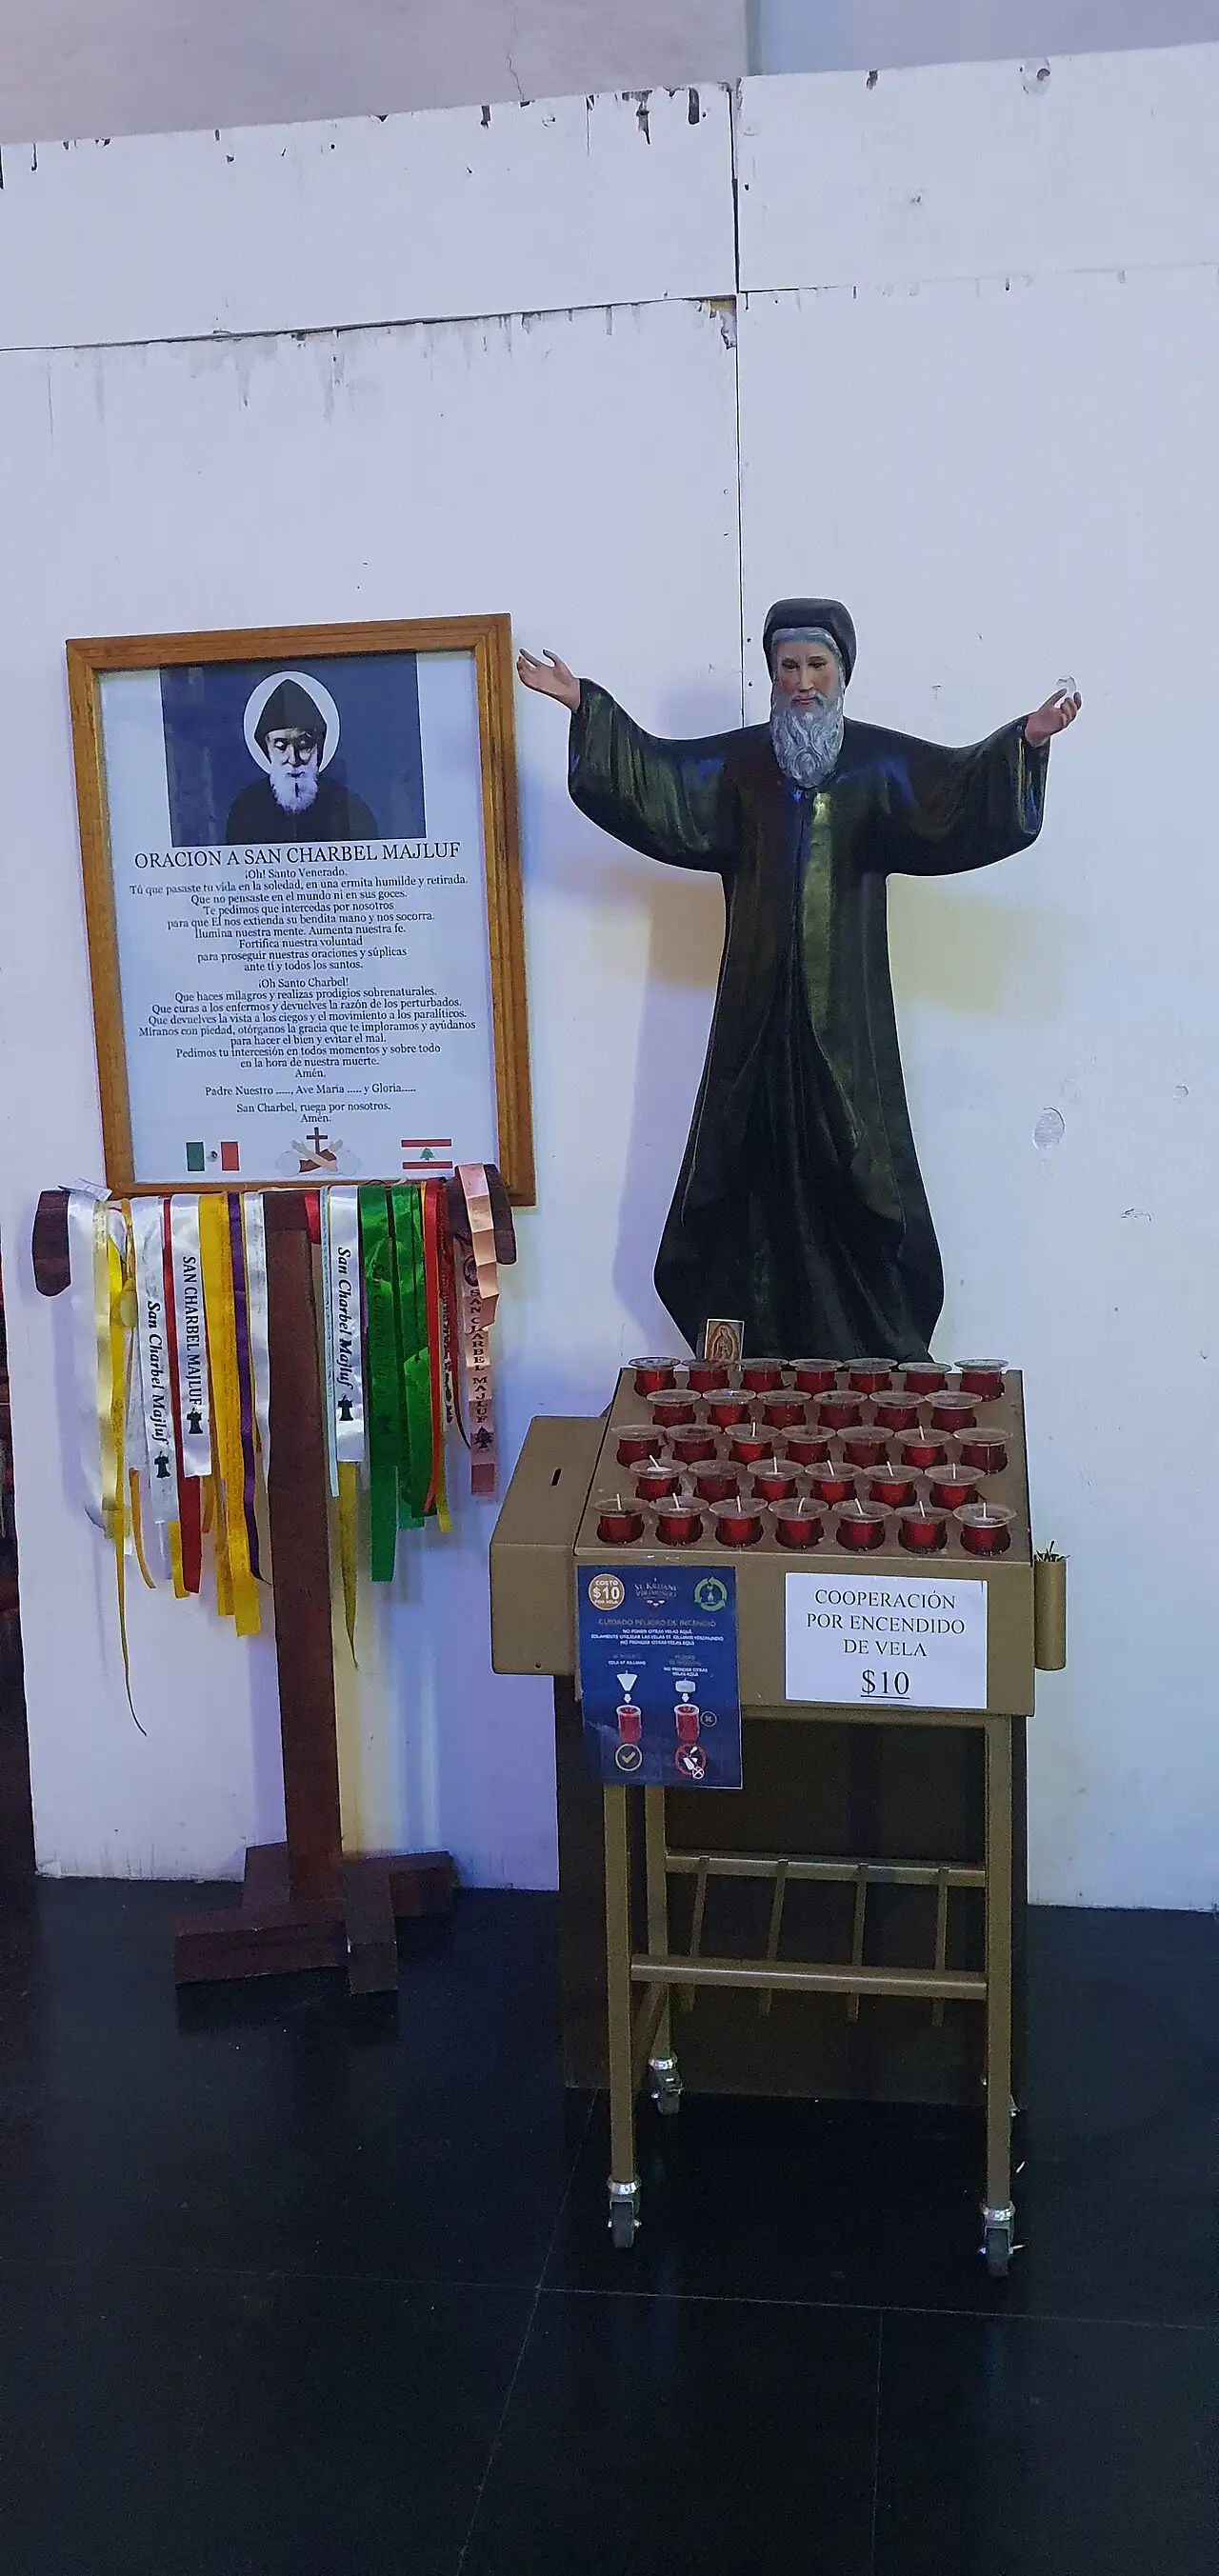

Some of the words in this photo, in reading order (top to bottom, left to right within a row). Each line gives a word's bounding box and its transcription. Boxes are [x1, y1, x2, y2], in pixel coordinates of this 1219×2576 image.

[134, 850, 221, 869] ORACION
[227, 849, 240, 865] A
[244, 848, 281, 865] SAN
[287, 845, 377, 863] CHARBEL
[382, 842, 461, 860] MAJLUF
[268, 869, 296, 878] Santo
[298, 866, 348, 877] Venerado.
[146, 887, 164, 896] que
[166, 884, 201, 896] pasaste
[215, 882, 236, 891] vida
[264, 879, 304, 890] soledad,
[341, 877, 373, 888] ermita
[375, 876, 416, 887] humilde
[427, 874, 469, 885] retirada.
[190, 894, 210, 907] Que
[228, 893, 270, 906] pensaste
[296, 890, 331, 901] mundo
[378, 890, 408, 900] goces.
[218, 905, 259, 917] pedimos
[261, 906, 279, 916] que
[281, 902, 331, 913] intercedas
[333, 904, 350, 913] por
[352, 902, 394, 910] nosotros
[168, 920, 189, 929] para
[190, 919, 209, 929] que
[243, 915, 284, 926] extienda
[300, 913, 336, 924] bendita
[195, 929, 232, 939] Ilumina
[235, 929, 271, 937] nuestra
[273, 928, 306, 936] mente.
[309, 926, 353, 935] Aumenta
[355, 925, 392, 934] nuestra
[394, 923, 406, 932] fe.
[239, 938, 279, 949] Fortifica
[282, 938, 318, 948] nuestra
[319, 935, 363, 947] voluntad
[197, 954, 218, 964] para
[221, 950, 267, 964] proseguir
[269, 950, 310, 960] nuestras
[311, 949, 358, 958] oraciones
[368, 947, 407, 959] súplicas
[244, 962, 265, 971] ante
[285, 960, 311, 970] todos
[313, 960, 327, 969] los
[329, 960, 364, 969] santos.
[278, 978, 306, 988] Santo
[308, 976, 349, 988] Charbel!
[174, 992, 194, 1004] Que
[196, 991, 224, 1001] haces
[226, 990, 268, 1003] milagros
[277, 989, 313, 999] realizas
[316, 988, 361, 1001] prodigios
[363, 987, 437, 997] sobrenaturales.
[152, 1005, 172, 1016] Que
[210, 1003, 224, 1012] los
[226, 1002, 270, 1012] enfermos
[280, 1000, 327, 1010] devuelves
[340, 999, 368, 1009] razón
[384, 998, 398, 1008] los
[400, 997, 462, 1010] perturbados.
[149, 1016, 168, 1028] Que
[170, 1015, 217, 1026] devuelves
[230, 1014, 252, 1024] vista
[263, 1013, 276, 1023] los
[278, 1012, 308, 1025] ciegos
[329, 1010, 387, 1021] movimiento
[397, 1009, 411, 1019] los
[413, 1008, 467, 1021] paralíticos.
[200, 1025, 235, 1037] piedad,
[237, 1024, 286, 1036] otórganos
[298, 1023, 328, 1035] gracia
[330, 1025, 348, 1034] que
[362, 1021, 419, 1033] imploramos
[429, 1019, 476, 1032] ayúdanos
[230, 1038, 251, 1048] para
[254, 1035, 281, 1045] hacer
[293, 1034, 314, 1044] bien
[324, 1033, 352, 1044] evitar
[365, 1032, 387, 1043] mal.
[176, 1048, 217, 1058] Pedimos
[231, 1046, 284, 1057] intercesión
[301, 1046, 327, 1055] todos
[330, 1046, 380, 1055] momentos
[390, 1044, 417, 1053] sobre
[419, 1043, 441, 1053] todo
[266, 1058, 287, 1068] hora
[304, 1058, 340, 1067] nuestra
[342, 1057, 379, 1066] muerte.
[295, 1068, 326, 1078] Amén.
[205, 1086, 232, 1096] Padre
[235, 1086, 274, 1095] Nuestro
[295, 1085, 314, 1094] Ave
[236, 1103, 254, 1113] San
[257, 1102, 297, 1113] Charbel,
[300, 1104, 327, 1113] ruega
[329, 1104, 346, 1113] por
[348, 1102, 391, 1110] nosotros.
[300, 1112, 331, 1123] Amén.
[183, 1256, 197, 1283] SAN
[337, 1247, 351, 1274] San
[338, 1279, 352, 1335] Charbel
[470, 1288, 482, 1314] SAN
[147, 1301, 161, 1329] San
[185, 1287, 200, 1351] CHARBEL
[149, 1333, 164, 1390] Charbel
[337, 1337, 354, 1390] Majluf
[187, 1354, 202, 1406] MAJLUF
[473, 1376, 488, 1424] MAJLUF
[150, 1394, 170, 1446] Majluf
[592, 1587, 620, 1600] $10
[815, 1588, 956, 1609] COOPERACIÓN
[807, 1613, 844, 1629] POR
[849, 1615, 966, 1634] ENCENDIDO
[844, 1639, 869, 1655] DE
[875, 1641, 928, 1657] VELA
[861, 1668, 909, 1695] $10
